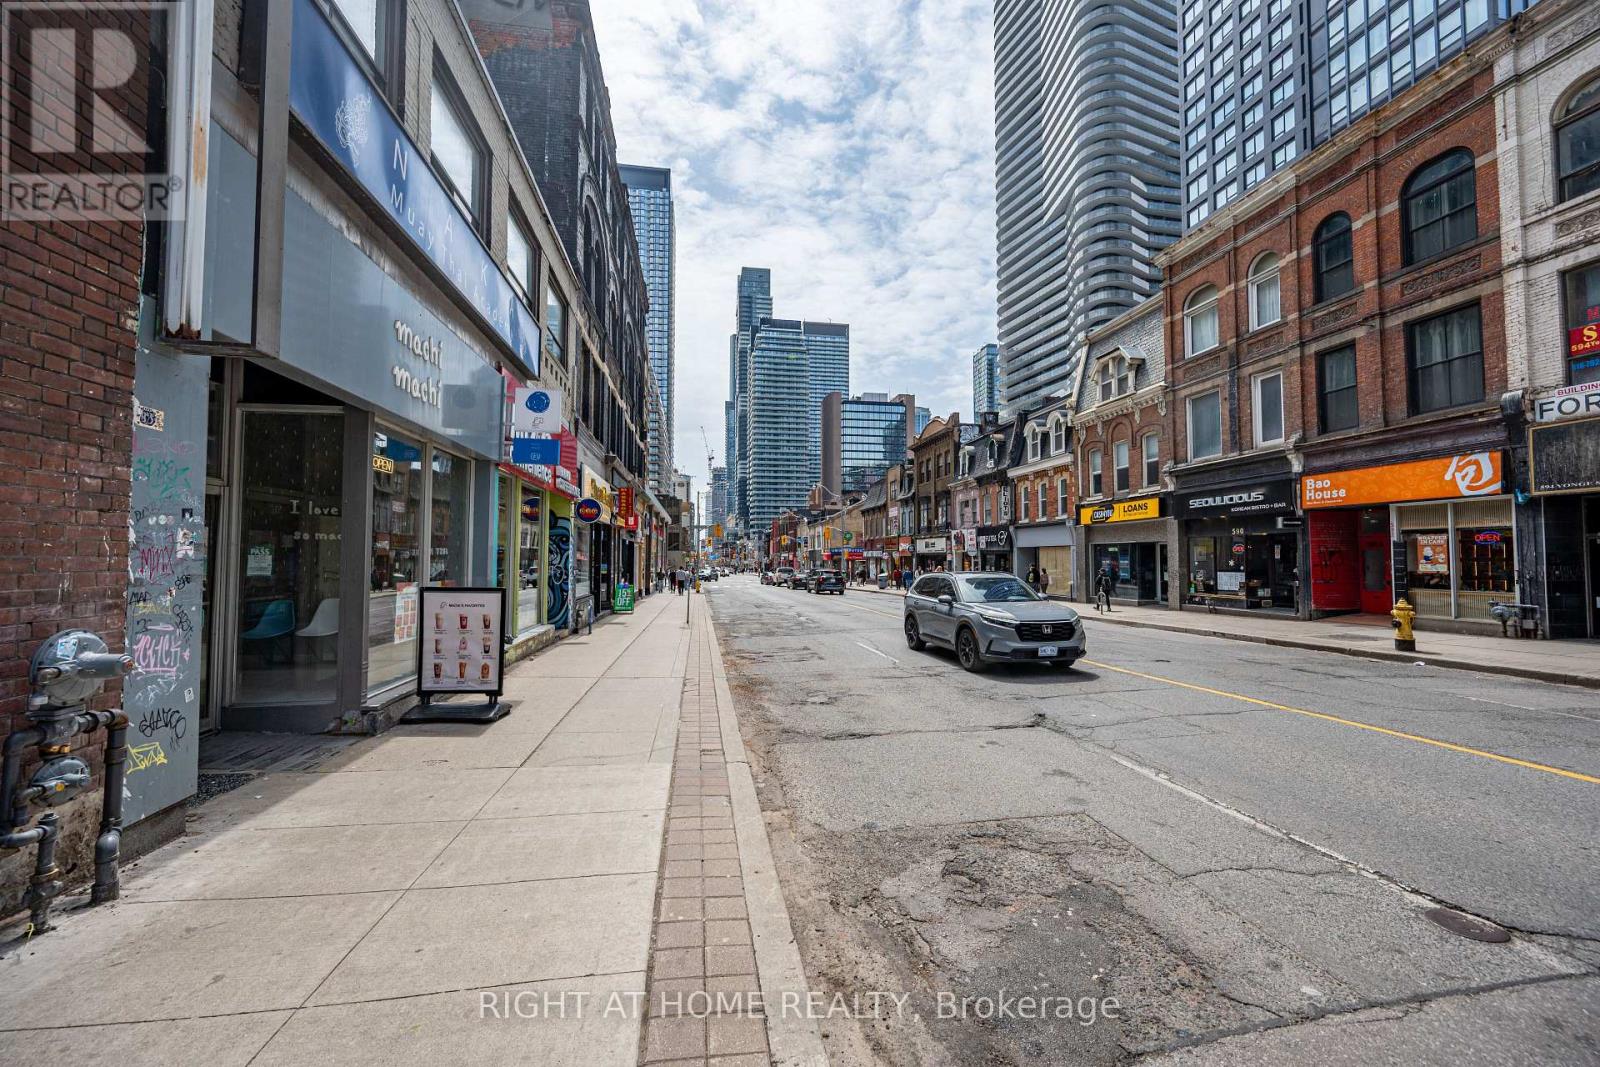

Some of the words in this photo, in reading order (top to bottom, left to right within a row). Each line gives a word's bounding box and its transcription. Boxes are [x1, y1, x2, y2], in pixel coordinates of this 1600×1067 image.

[390, 183, 434, 251] Muay
[394, 320, 443, 369] machi
[392, 366, 442, 409] machi
[1557, 383, 1600, 396] BUILDIN
[1539, 393, 1600, 419] FOR
[373, 458, 393, 472] OPEN
[1306, 479, 1330, 490] Bao
[1306, 488, 1346, 501] House
[290, 499, 300, 514] I
[308, 500, 340, 515] love
[1123, 502, 1149, 513] LOANS
[1232, 527, 1244, 535] 590
[1475, 534, 1501, 542] OPEN
